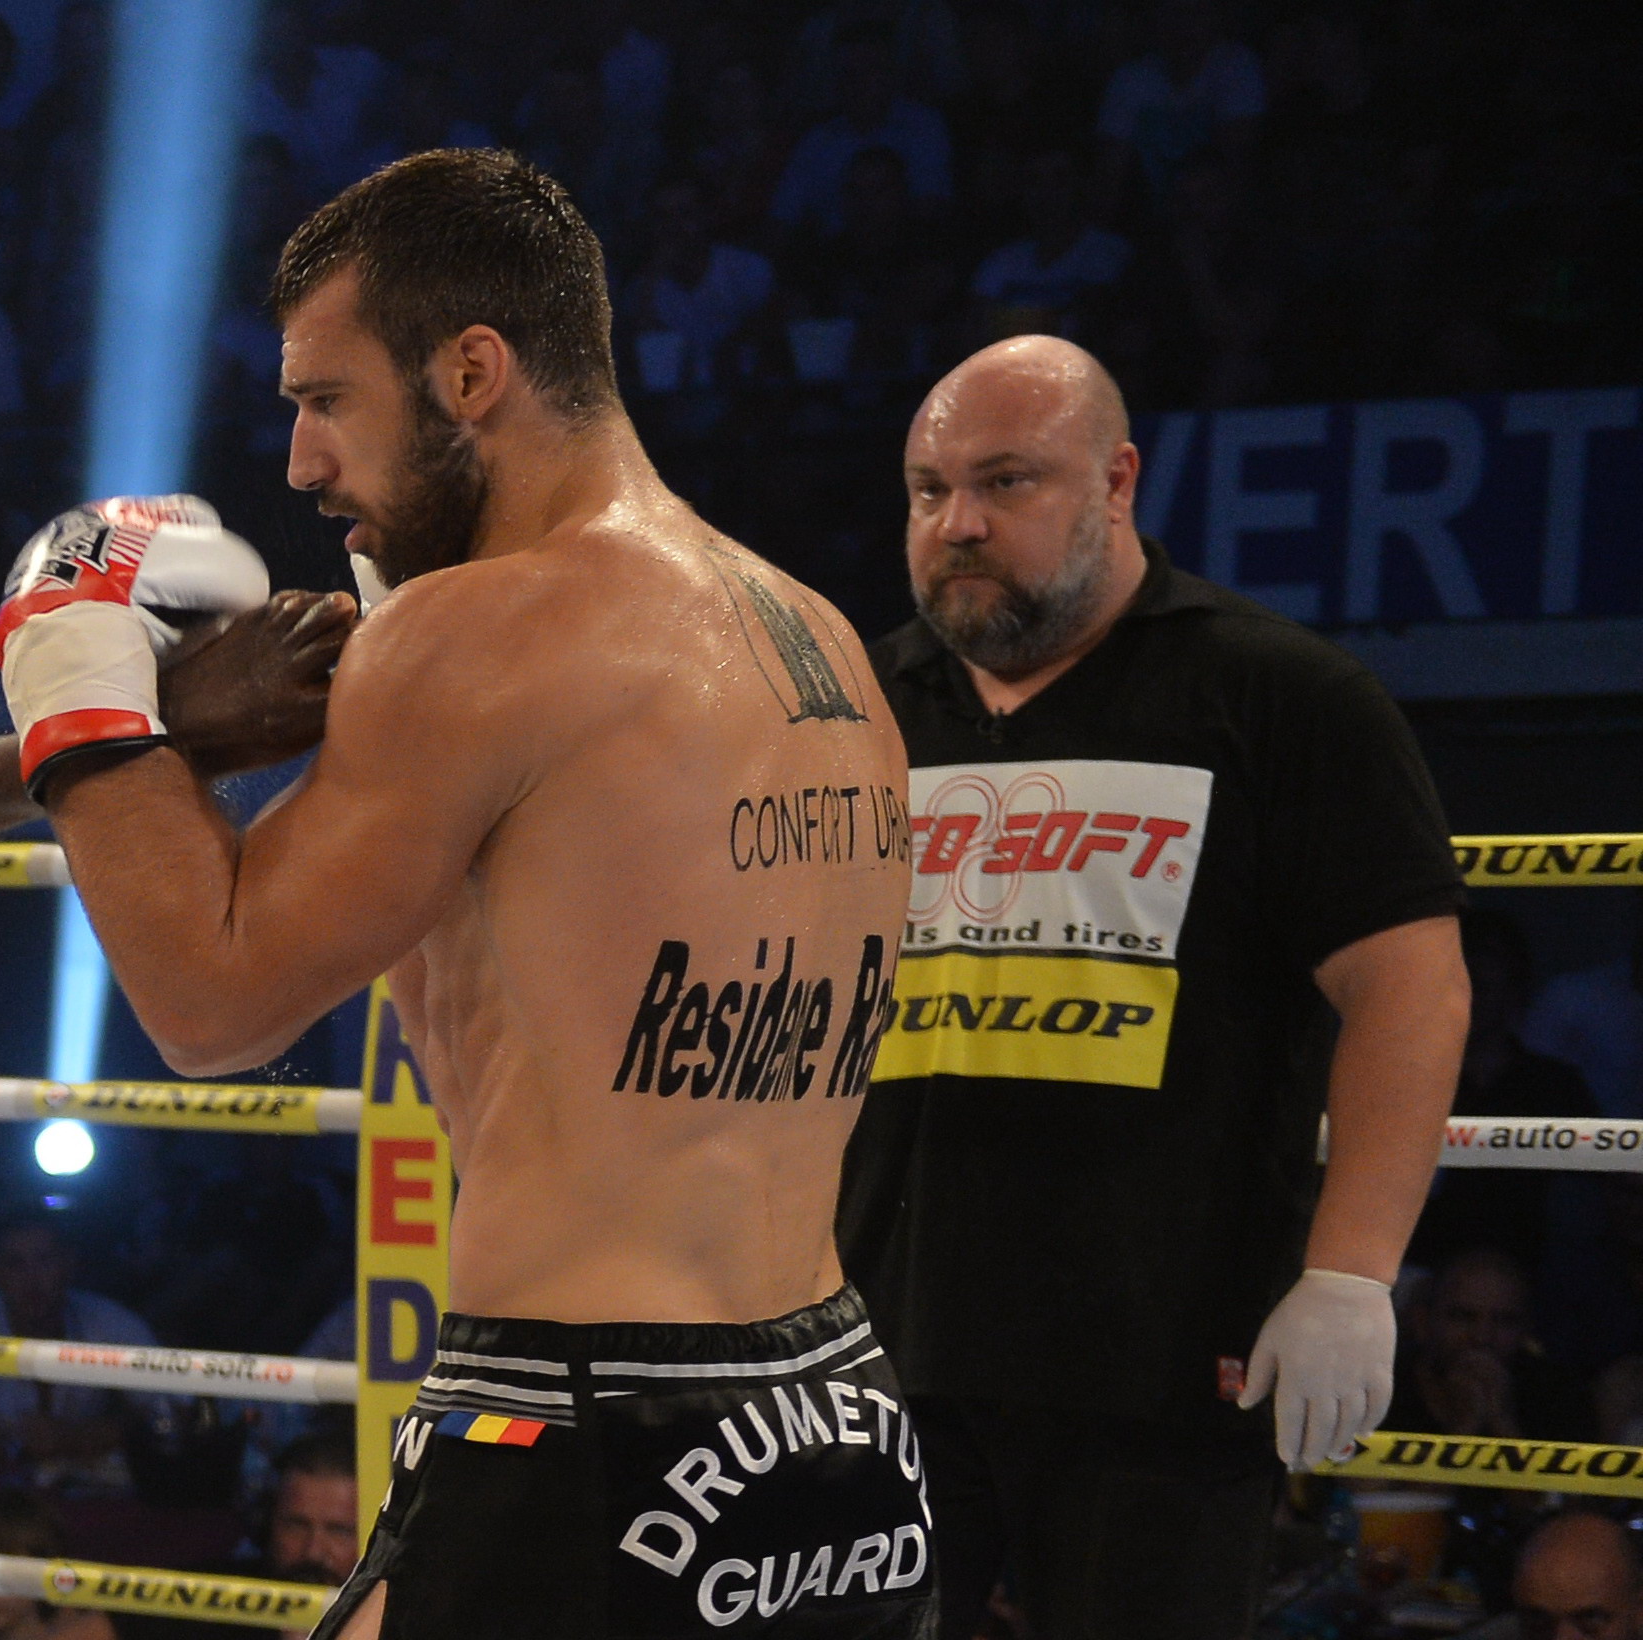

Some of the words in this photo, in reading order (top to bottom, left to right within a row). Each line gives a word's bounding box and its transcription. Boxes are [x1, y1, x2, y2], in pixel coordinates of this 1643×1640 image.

[982, 812, 1190, 878] SOFT
[959, 918, 1040, 946] and
[1062, 921, 1163, 953] tires
[1379, 1438, 1643, 1478] DUNLO
[697, 1523, 928, 1628] GUARD
